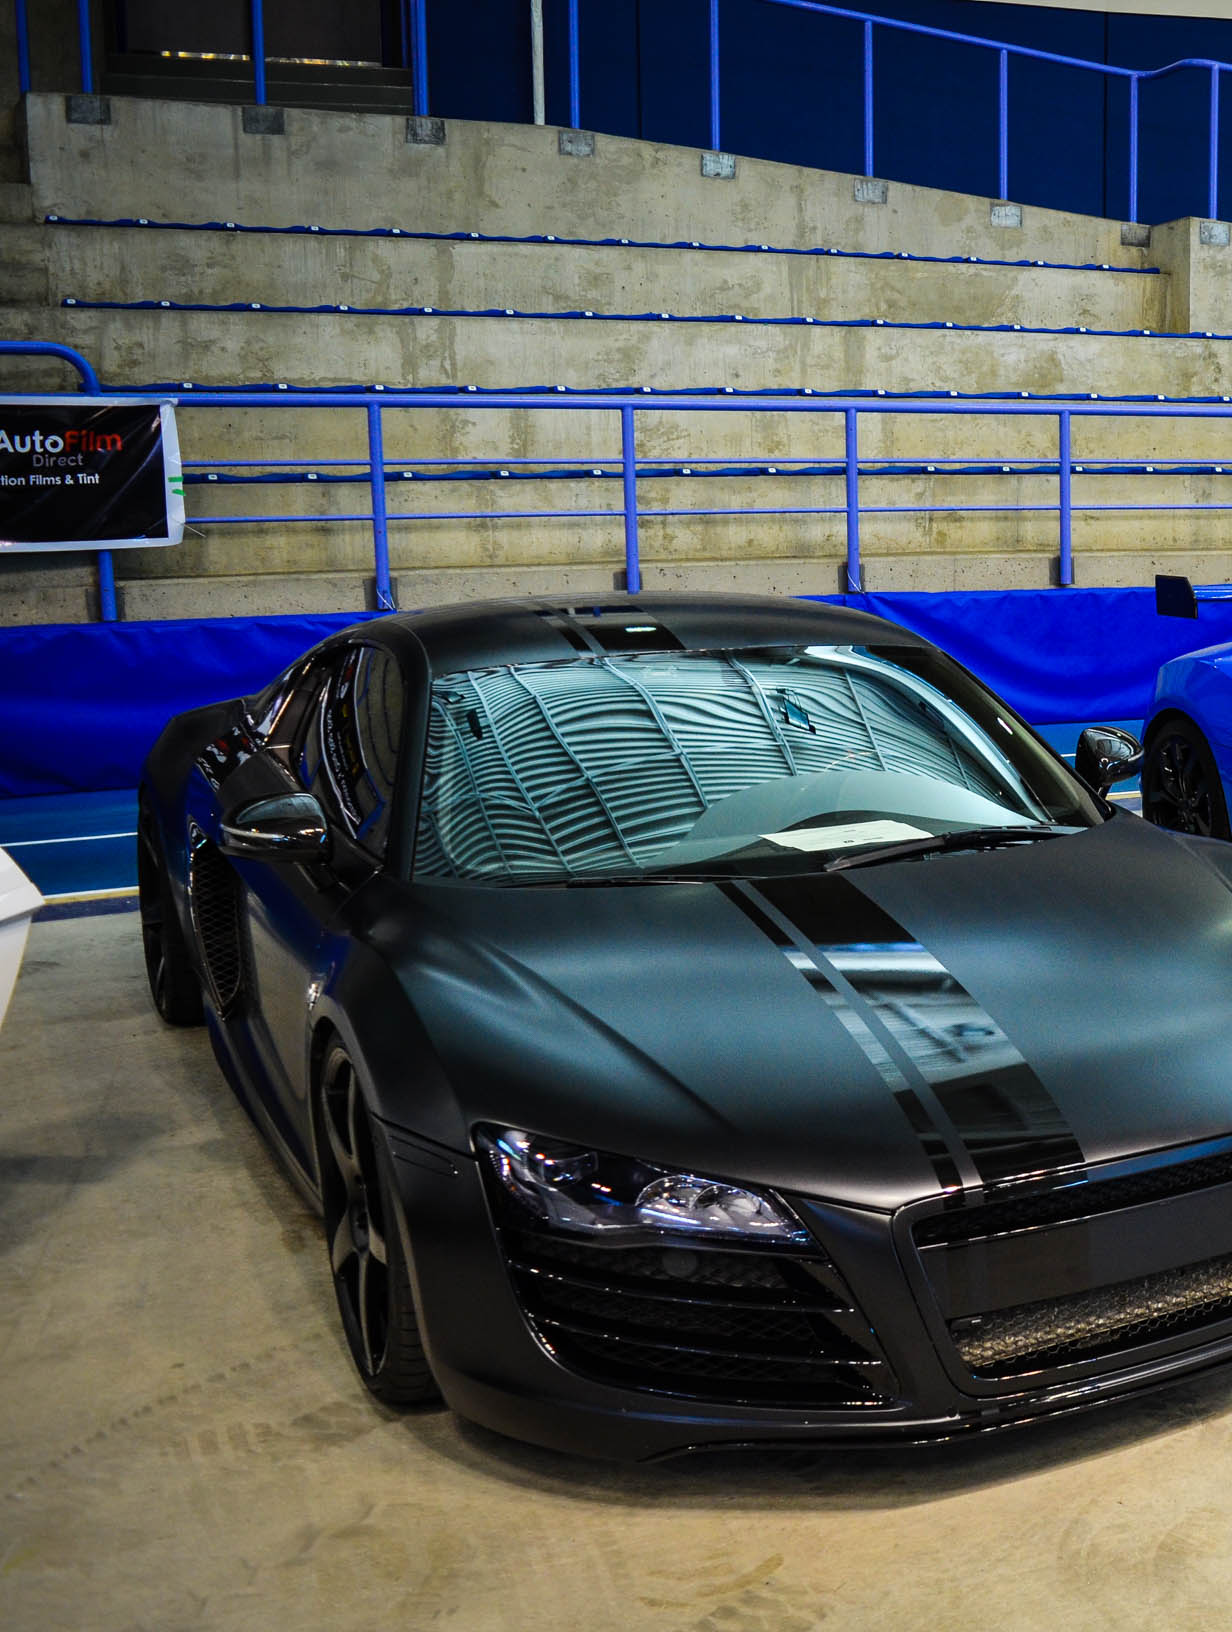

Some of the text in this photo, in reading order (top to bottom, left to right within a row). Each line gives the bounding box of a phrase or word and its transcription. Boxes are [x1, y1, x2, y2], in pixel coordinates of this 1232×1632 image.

[0, 429, 123, 453] AutoFilm
[32, 453, 84, 467] Direct
[29, 474, 62, 485] Films
[64, 474, 74, 485] &
[77, 473, 100, 484] Tint
